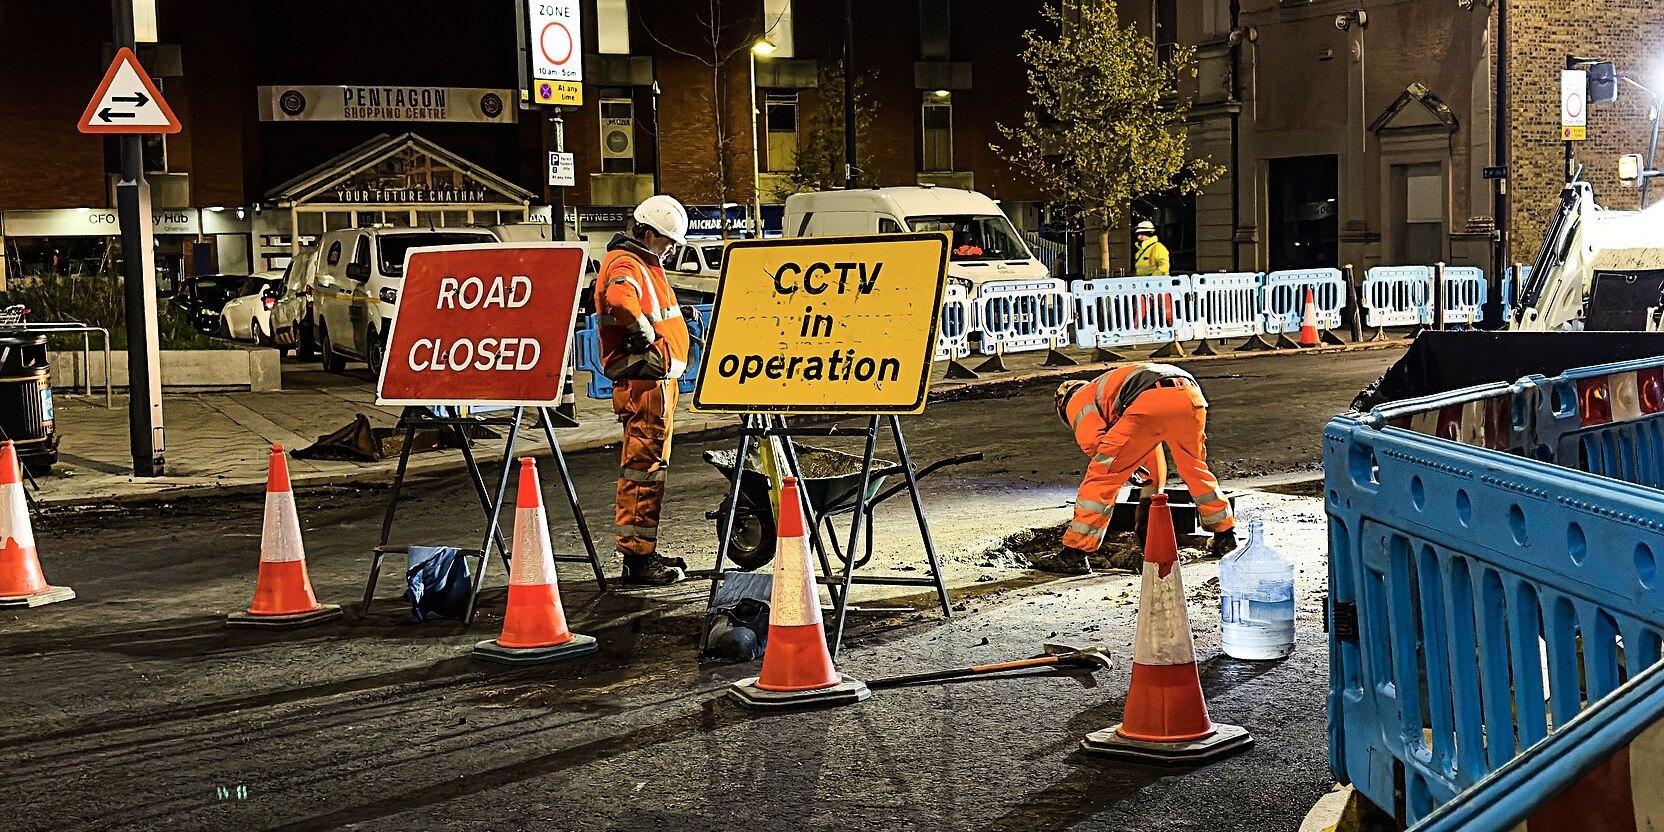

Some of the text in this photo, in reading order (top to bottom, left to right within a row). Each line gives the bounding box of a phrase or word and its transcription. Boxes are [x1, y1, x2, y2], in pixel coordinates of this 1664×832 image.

[539, 5, 570, 17] ZONE
[343, 87, 446, 107] PENTAGON
[344, 107, 446, 119] SHOPPING CENTRE
[337, 190, 485, 202] YOUR FUTURE CHATHAM
[89, 213, 116, 224] CFO
[164, 212, 189, 223] Hub
[580, 213, 624, 222] FITNESS
[688, 218, 725, 230] MICHAE
[773, 262, 884, 295] CCTV
[436, 275, 532, 310] ROAD
[800, 305, 834, 338] in
[408, 337, 541, 372] CLOSED
[717, 348, 901, 385] operation
